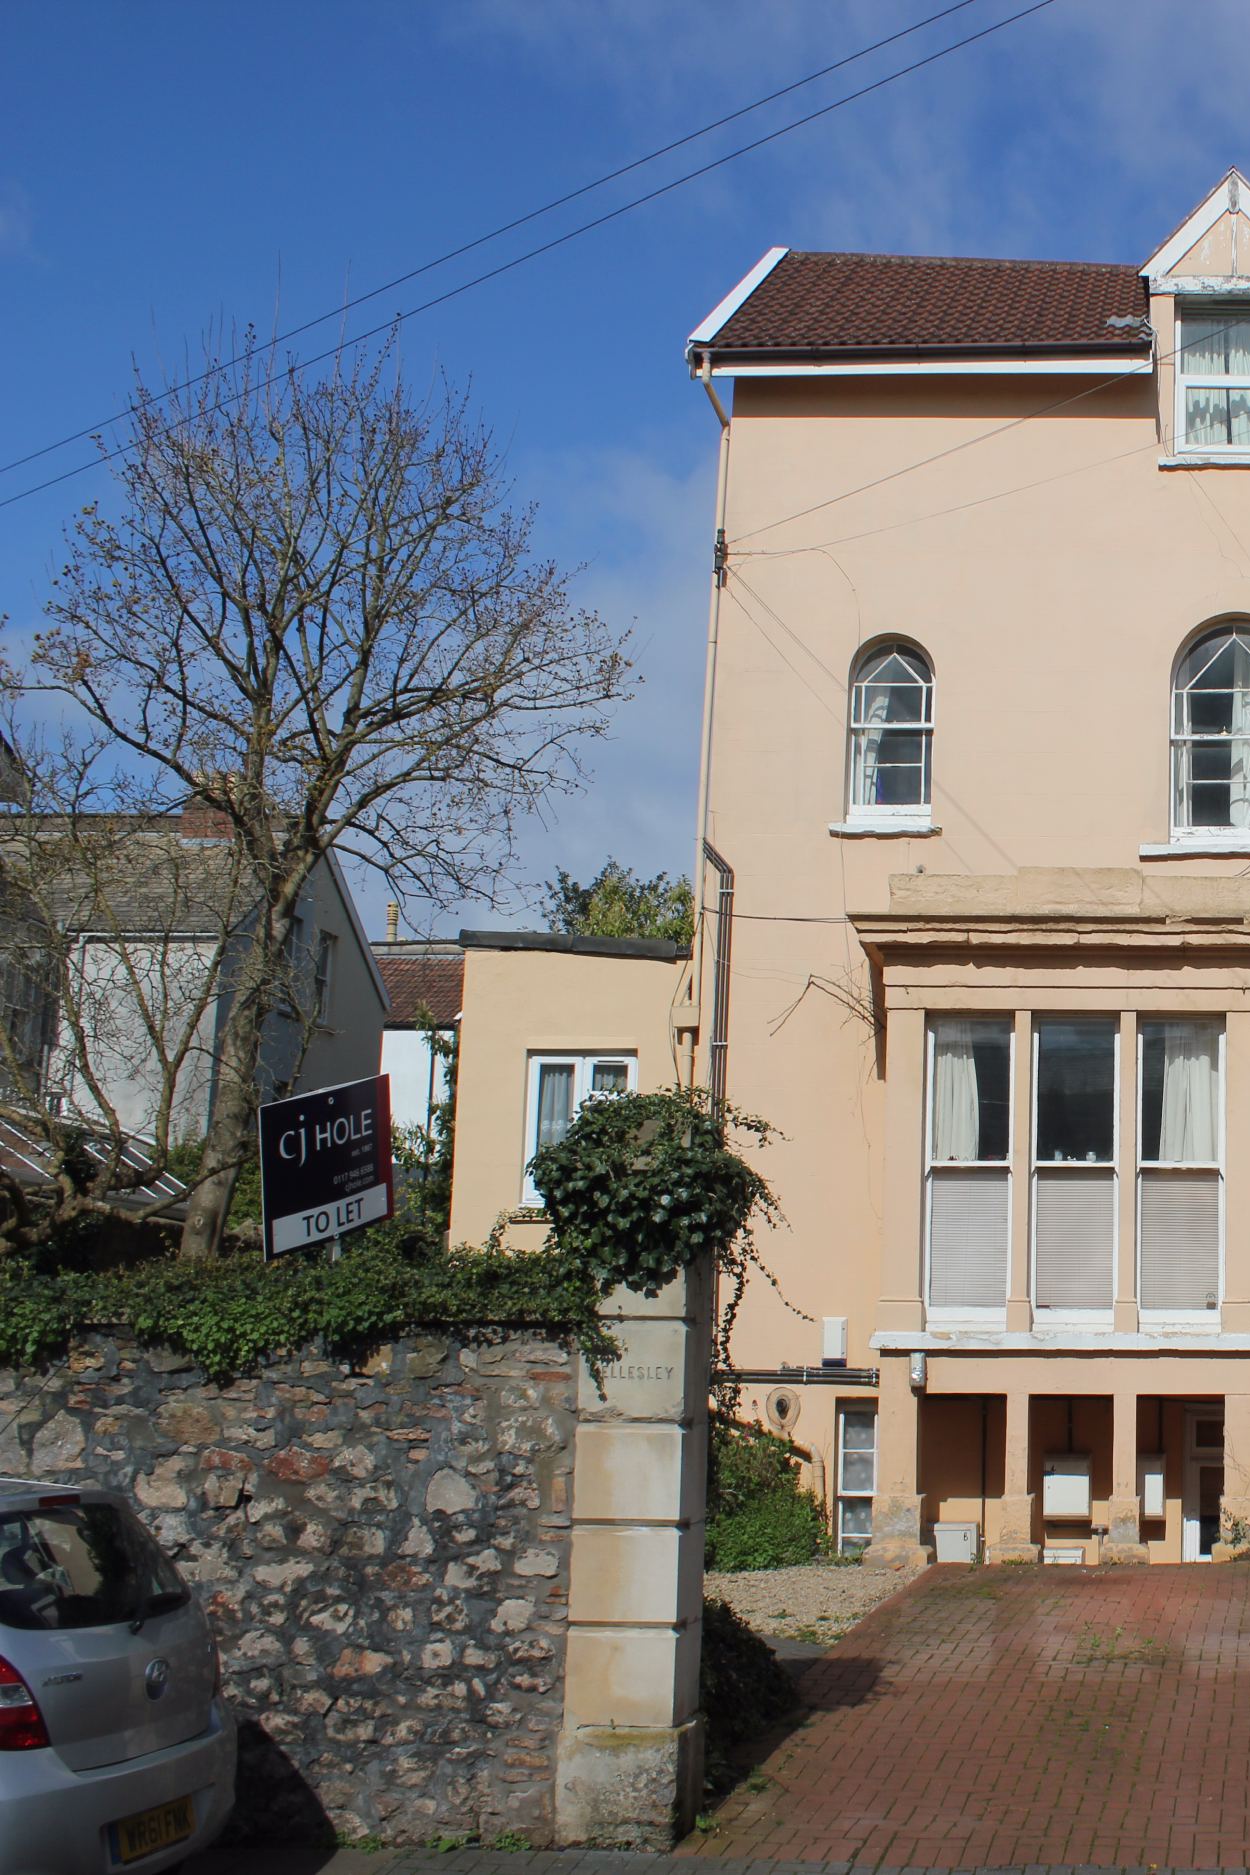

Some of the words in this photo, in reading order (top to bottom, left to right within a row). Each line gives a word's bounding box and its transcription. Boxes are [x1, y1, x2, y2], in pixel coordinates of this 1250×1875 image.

[315, 1109, 373, 1150] HOLE
[302, 1211, 330, 1237] TO
[336, 1197, 364, 1227] LET
[597, 1366, 674, 1380] ELLESLEY
